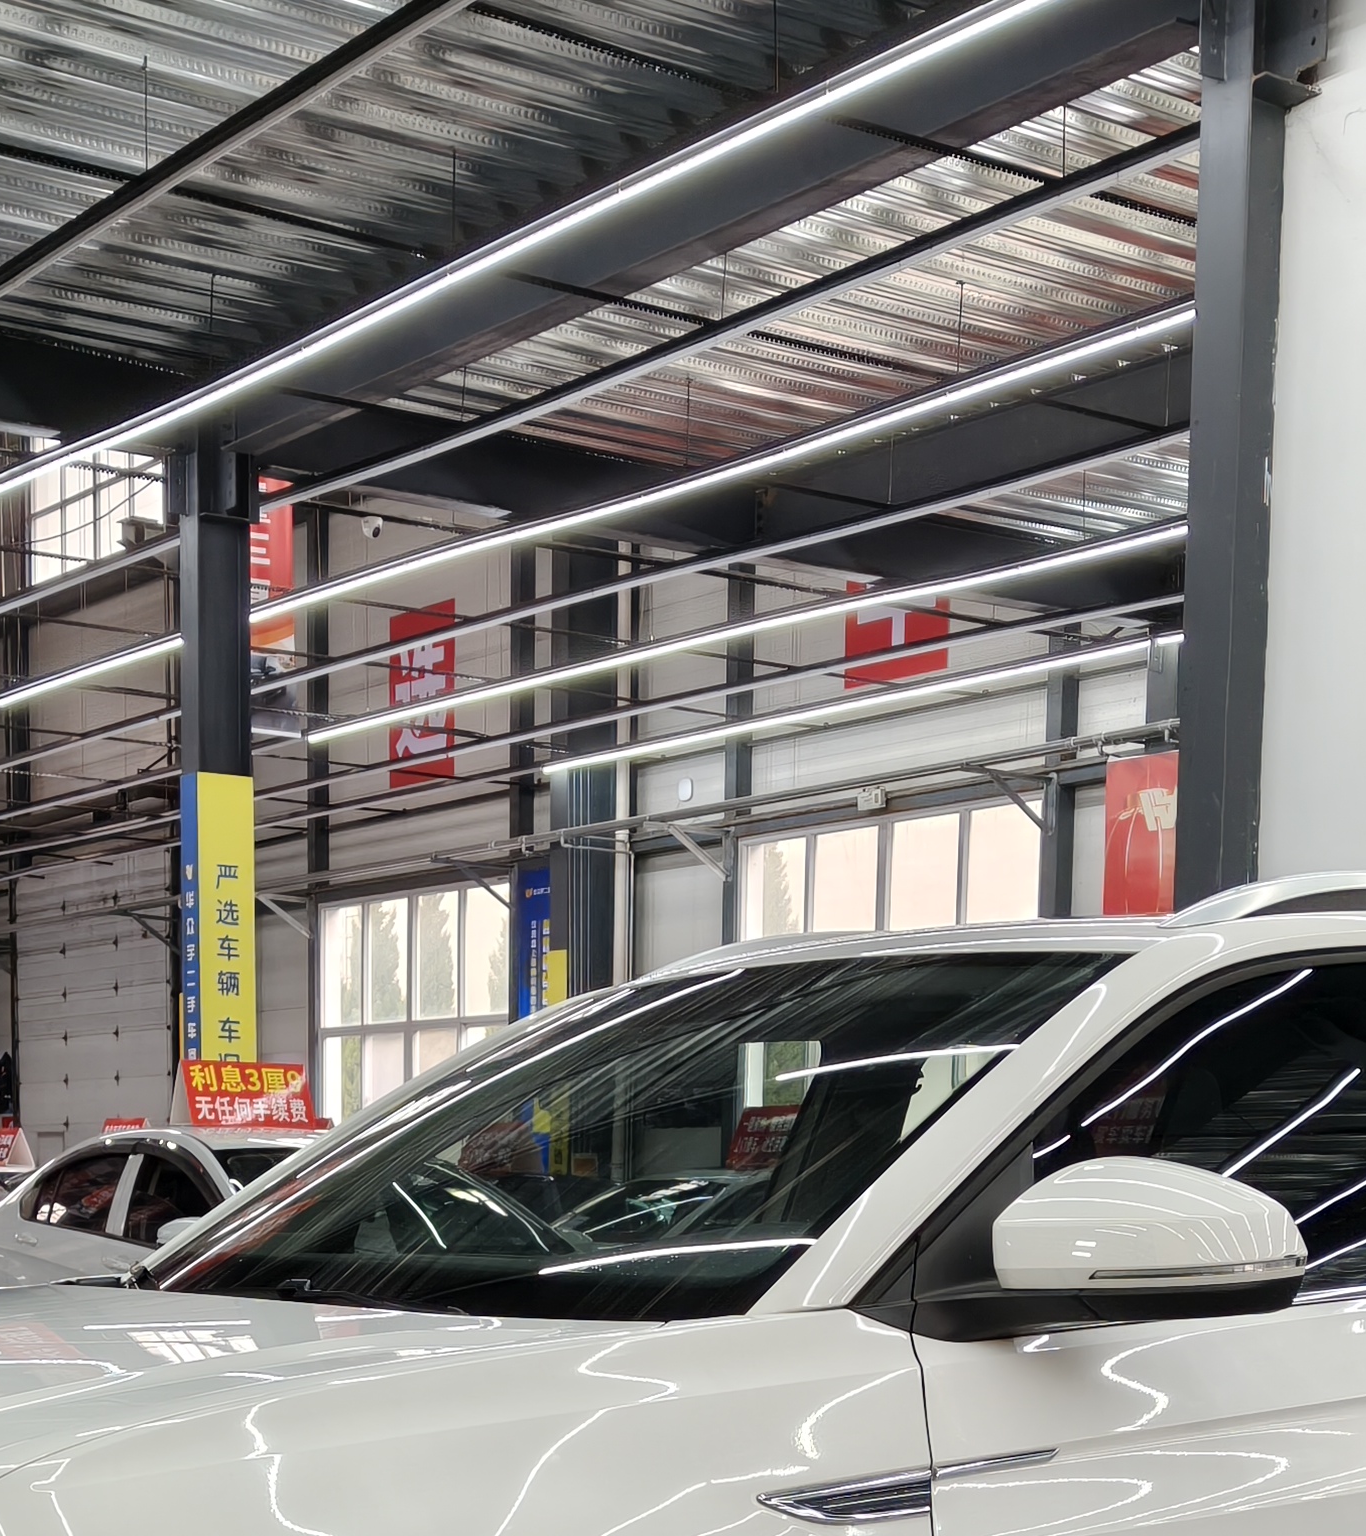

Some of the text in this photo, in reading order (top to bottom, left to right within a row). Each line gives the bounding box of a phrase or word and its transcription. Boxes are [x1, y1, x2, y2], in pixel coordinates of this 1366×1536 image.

[216, 864, 240, 996] 严选车辆
[194, 1095, 309, 1123] 无任何手续费
